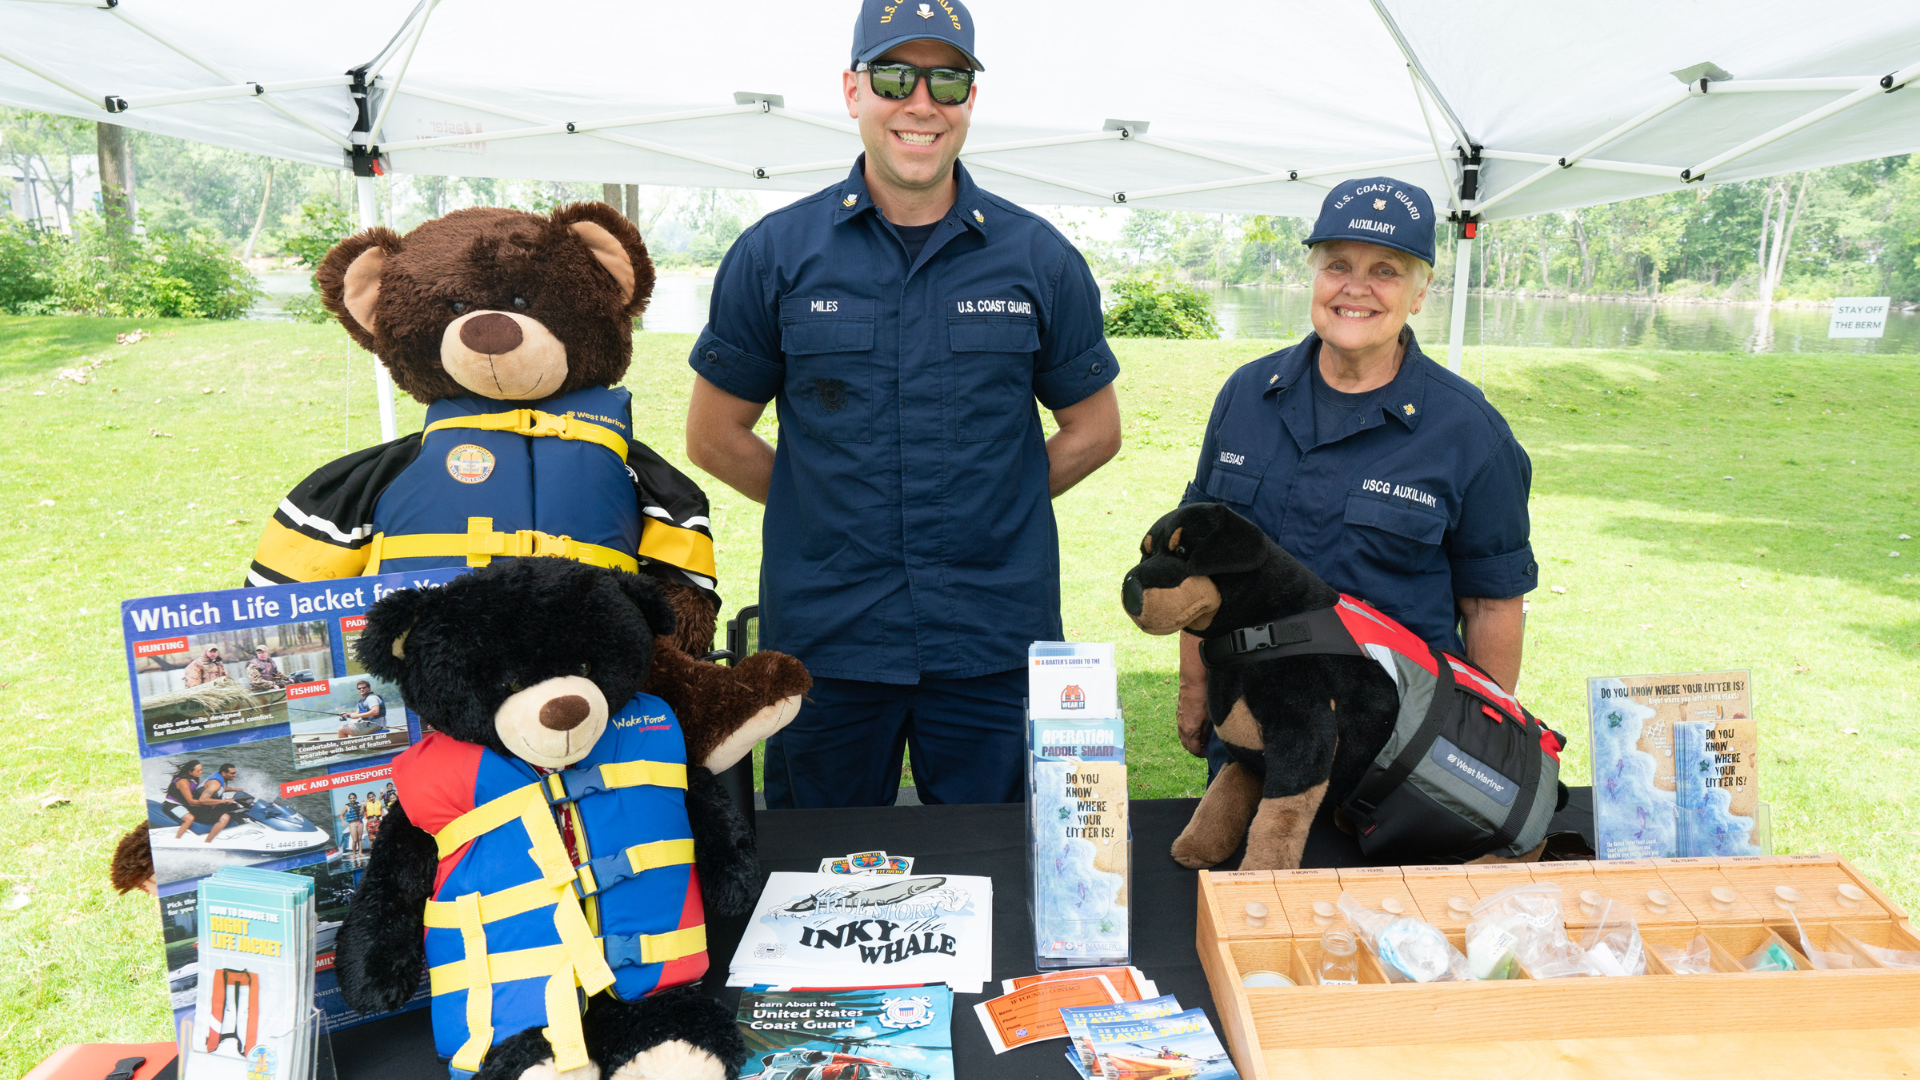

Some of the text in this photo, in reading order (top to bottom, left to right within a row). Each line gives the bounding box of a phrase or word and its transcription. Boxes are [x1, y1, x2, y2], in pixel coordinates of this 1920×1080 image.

[880, 0, 962, 30] U.S. UARD
[1334, 184, 1420, 220] U.S. COAST GUARD
[1348, 219, 1396, 235] AUXILIARY
[811, 301, 838, 312] MILES
[958, 300, 1031, 314] U.S. COAST GUARD
[1839, 306, 1884, 314] STAY OFF
[1835, 321, 1881, 329] THE BERM
[577, 411, 626, 430] West Marine
[1219, 452, 1245, 466] IGLESIAS
[1362, 479, 1437, 508] USCG AUXILIARY
[130, 601, 221, 632] Which
[232, 595, 280, 621] Life
[289, 587, 366, 619] Jacket
[138, 641, 184, 653] HUNTING
[290, 684, 326, 696] FISHING
[1601, 681, 1745, 699] DO YOU KNOW WHERE YOUR LITTER IS?
[1061, 701, 1085, 709] WEAR IT
[1648, 697, 1663, 706] Right
[1664, 696, 1680, 704] where
[1680, 697, 1691, 705] you
[1722, 692, 1740, 700] YEARS!
[152, 722, 174, 730] Coats
[210, 711, 241, 722] designed
[166, 725, 202, 735] floatation,
[203, 720, 230, 729] warmth
[246, 713, 274, 723] comfort.
[612, 715, 642, 730] Wake
[643, 714, 667, 725] Force
[1042, 729, 1114, 745] OPERATION
[1705, 729, 1735, 740] DO YOU
[298, 742, 339, 753] Comfortable,
[340, 735, 374, 746] convenient
[299, 750, 329, 760] wearable
[329, 748, 344, 756] with
[366, 740, 391, 749] features
[1042, 745, 1114, 757] PADDLE SMART
[1705, 741, 1728, 752] KNOW
[1714, 753, 1741, 764] WHERE
[1456, 758, 1502, 792] West Marine
[1715, 766, 1736, 776] YOUR
[286, 767, 393, 794] PWC AND WATERSPORTS
[1065, 772, 1099, 785] DO YOU
[1705, 776, 1747, 788] LITTER IS?
[1065, 787, 1092, 798] KNOW
[1077, 801, 1107, 812] WHERE
[1077, 814, 1102, 826] YOUR
[1066, 827, 1115, 838] LITTER IS?
[815, 886, 841, 898] the
[180, 907, 194, 915] you
[209, 905, 227, 915] HOW
[228, 907, 237, 917] TO
[266, 912, 279, 923] THE
[813, 898, 941, 920] TRUE STORY
[210, 915, 250, 935] RIGHT
[813, 917, 837, 928] of
[799, 915, 947, 949] INKY the
[211, 932, 282, 957] LIFE JACKET
[858, 932, 957, 965] WHALE
[1019, 991, 1045, 1003] FOUND
[1049, 986, 1081, 994] CONTACT
[785, 1000, 813, 1008] About
[818, 1000, 837, 1008] the
[753, 1008, 864, 1019] United States
[1073, 1008, 1172, 1026] HAVE FUN
[1089, 1010, 1126, 1018] SMART,
[750, 1019, 856, 1031] Coast Guard
[1099, 1031, 1155, 1042] HAVE
[1159, 1022, 1200, 1037] FUN
